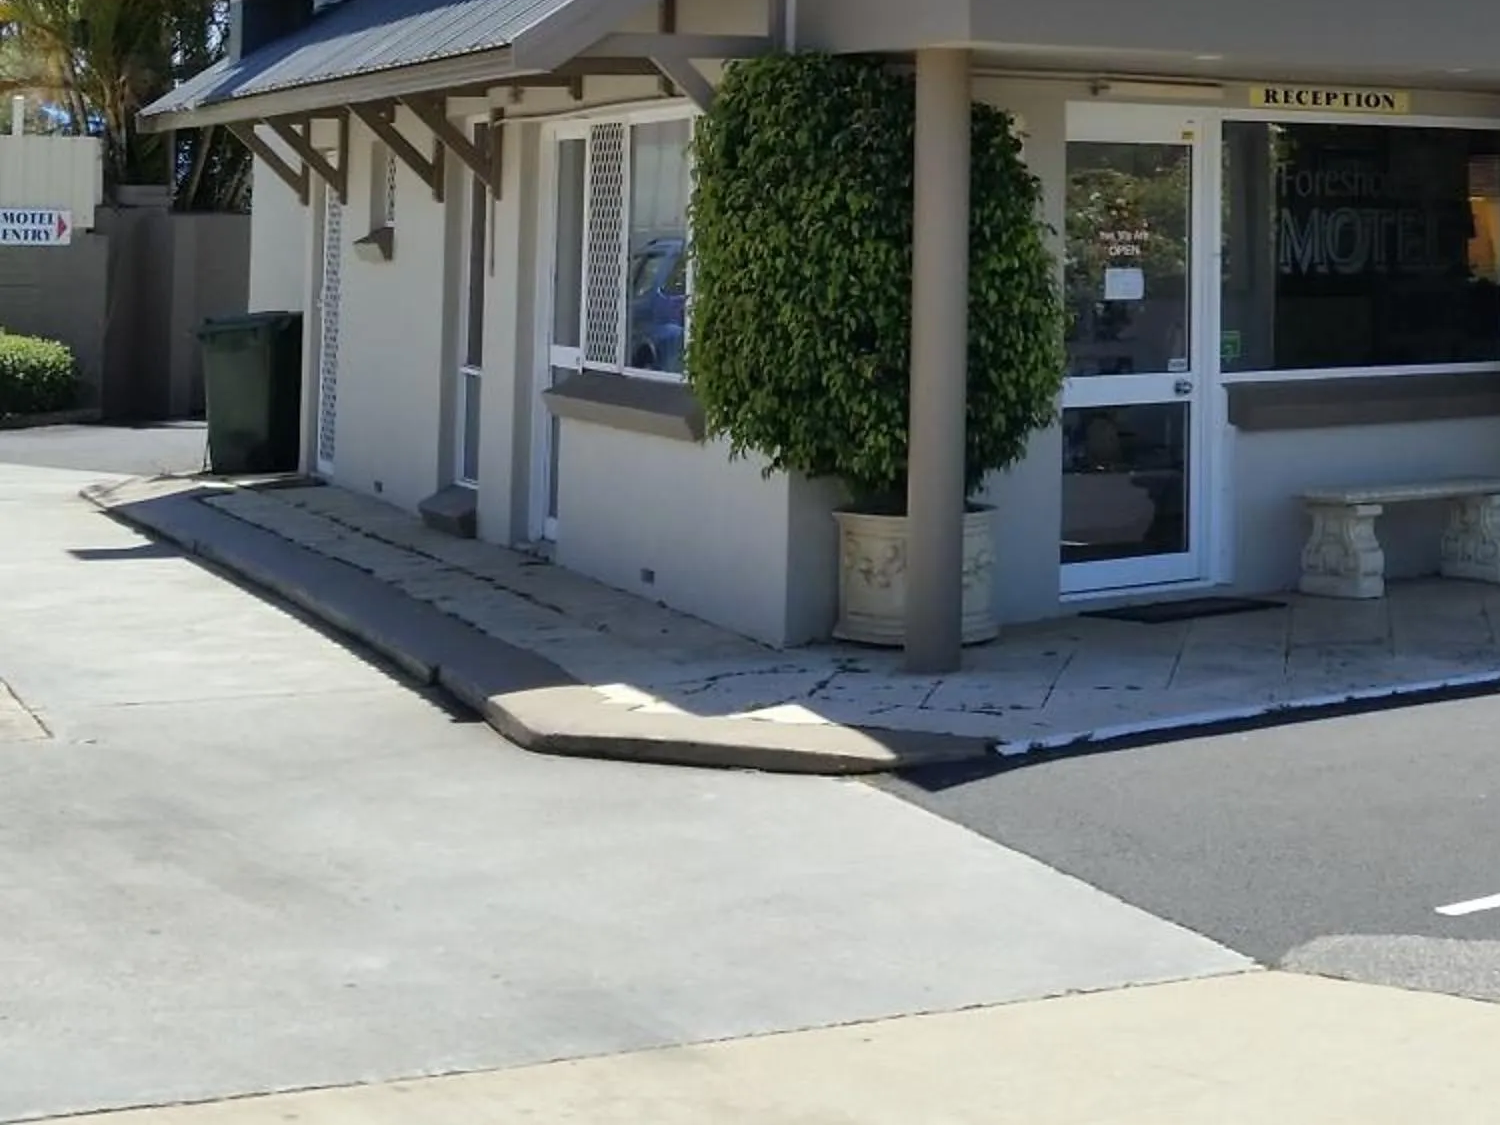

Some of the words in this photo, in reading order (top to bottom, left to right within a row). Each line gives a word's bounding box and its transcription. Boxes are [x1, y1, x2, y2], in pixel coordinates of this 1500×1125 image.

[1264, 88, 1395, 109] RECEPTION
[1278, 159, 1400, 198] Foresho
[2, 212, 54, 225] MOTEL
[2, 228, 51, 241] ENTRY
[1279, 206, 1450, 275] MOTEL
[1109, 246, 1141, 256] OPEN
